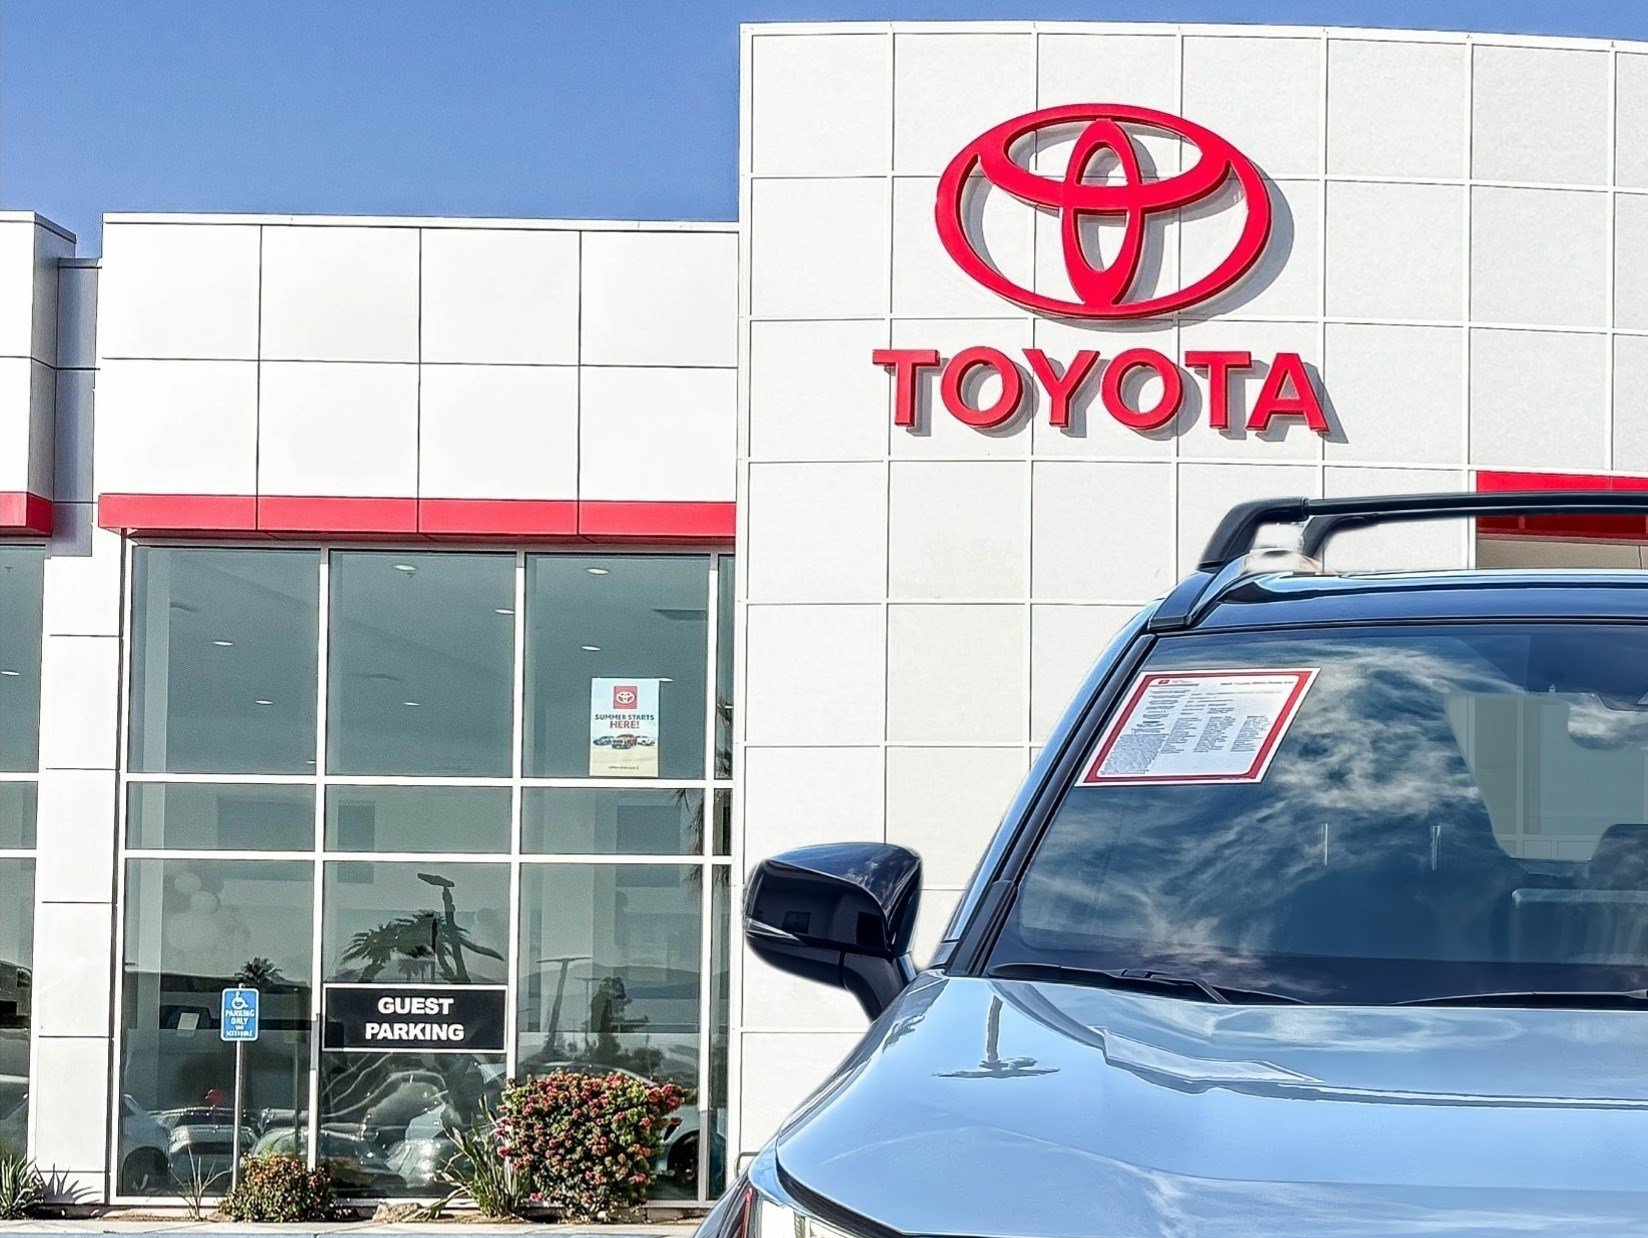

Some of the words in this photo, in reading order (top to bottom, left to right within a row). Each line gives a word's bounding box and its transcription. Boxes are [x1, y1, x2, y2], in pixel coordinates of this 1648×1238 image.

[872, 346, 1330, 432] TOYOTA
[610, 721, 640, 729] HERE!
[377, 996, 454, 1015] GUEST
[365, 1022, 465, 1041] PARKING
